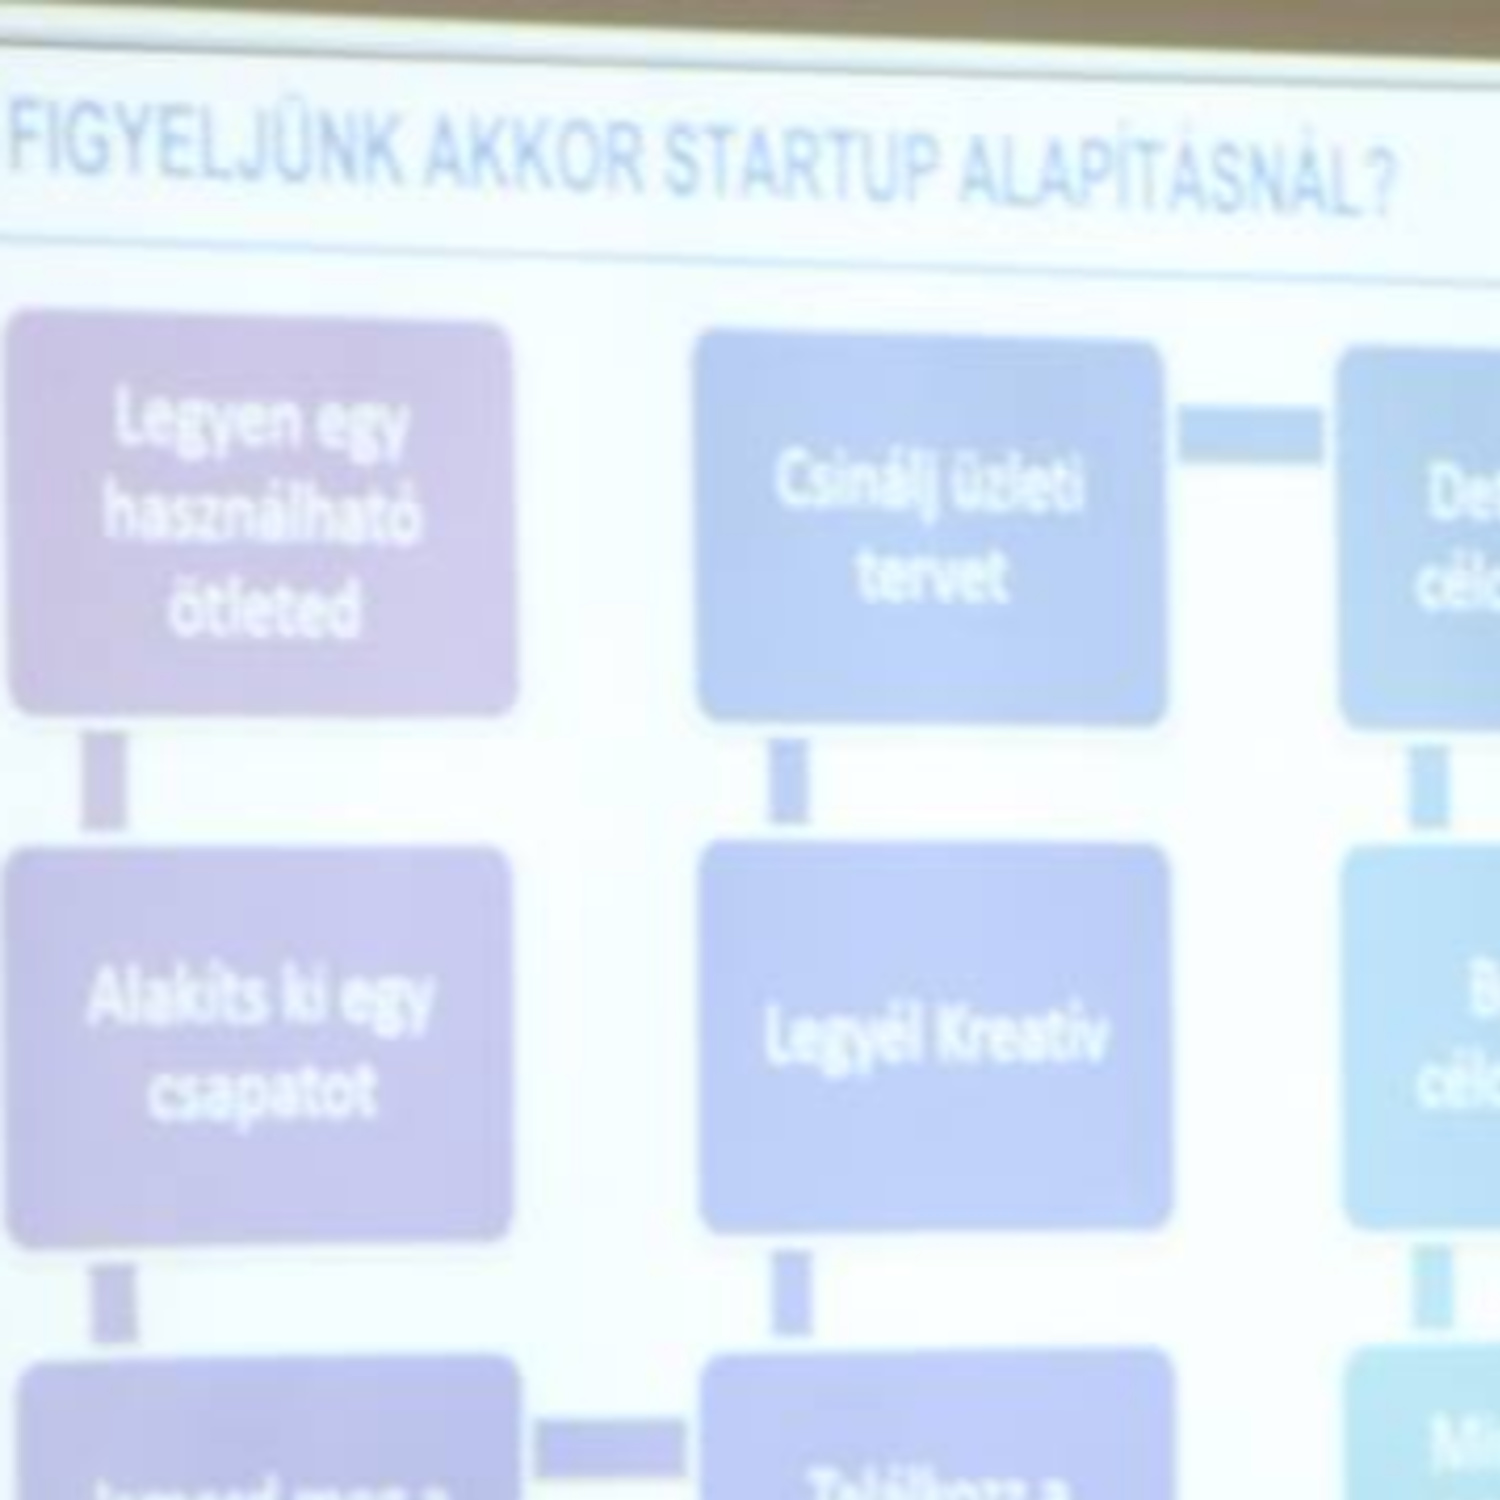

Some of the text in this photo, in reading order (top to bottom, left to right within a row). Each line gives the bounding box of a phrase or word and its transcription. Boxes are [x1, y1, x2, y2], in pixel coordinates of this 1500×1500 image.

[8, 95, 1398, 219] FIGYELJÜNK AKKOR STARTUP ALAPÍTÁSNÁL?
[114, 384, 410, 466] Legyen egy
[102, 473, 424, 548] használható
[775, 444, 1086, 522] Csinálj üzleti
[168, 574, 364, 640] ötleted
[855, 546, 1012, 604] tervet
[87, 954, 438, 1040] Alakíts ki egy
[764, 998, 925, 1080] Legyél
[147, 1060, 378, 1136] csapatot
